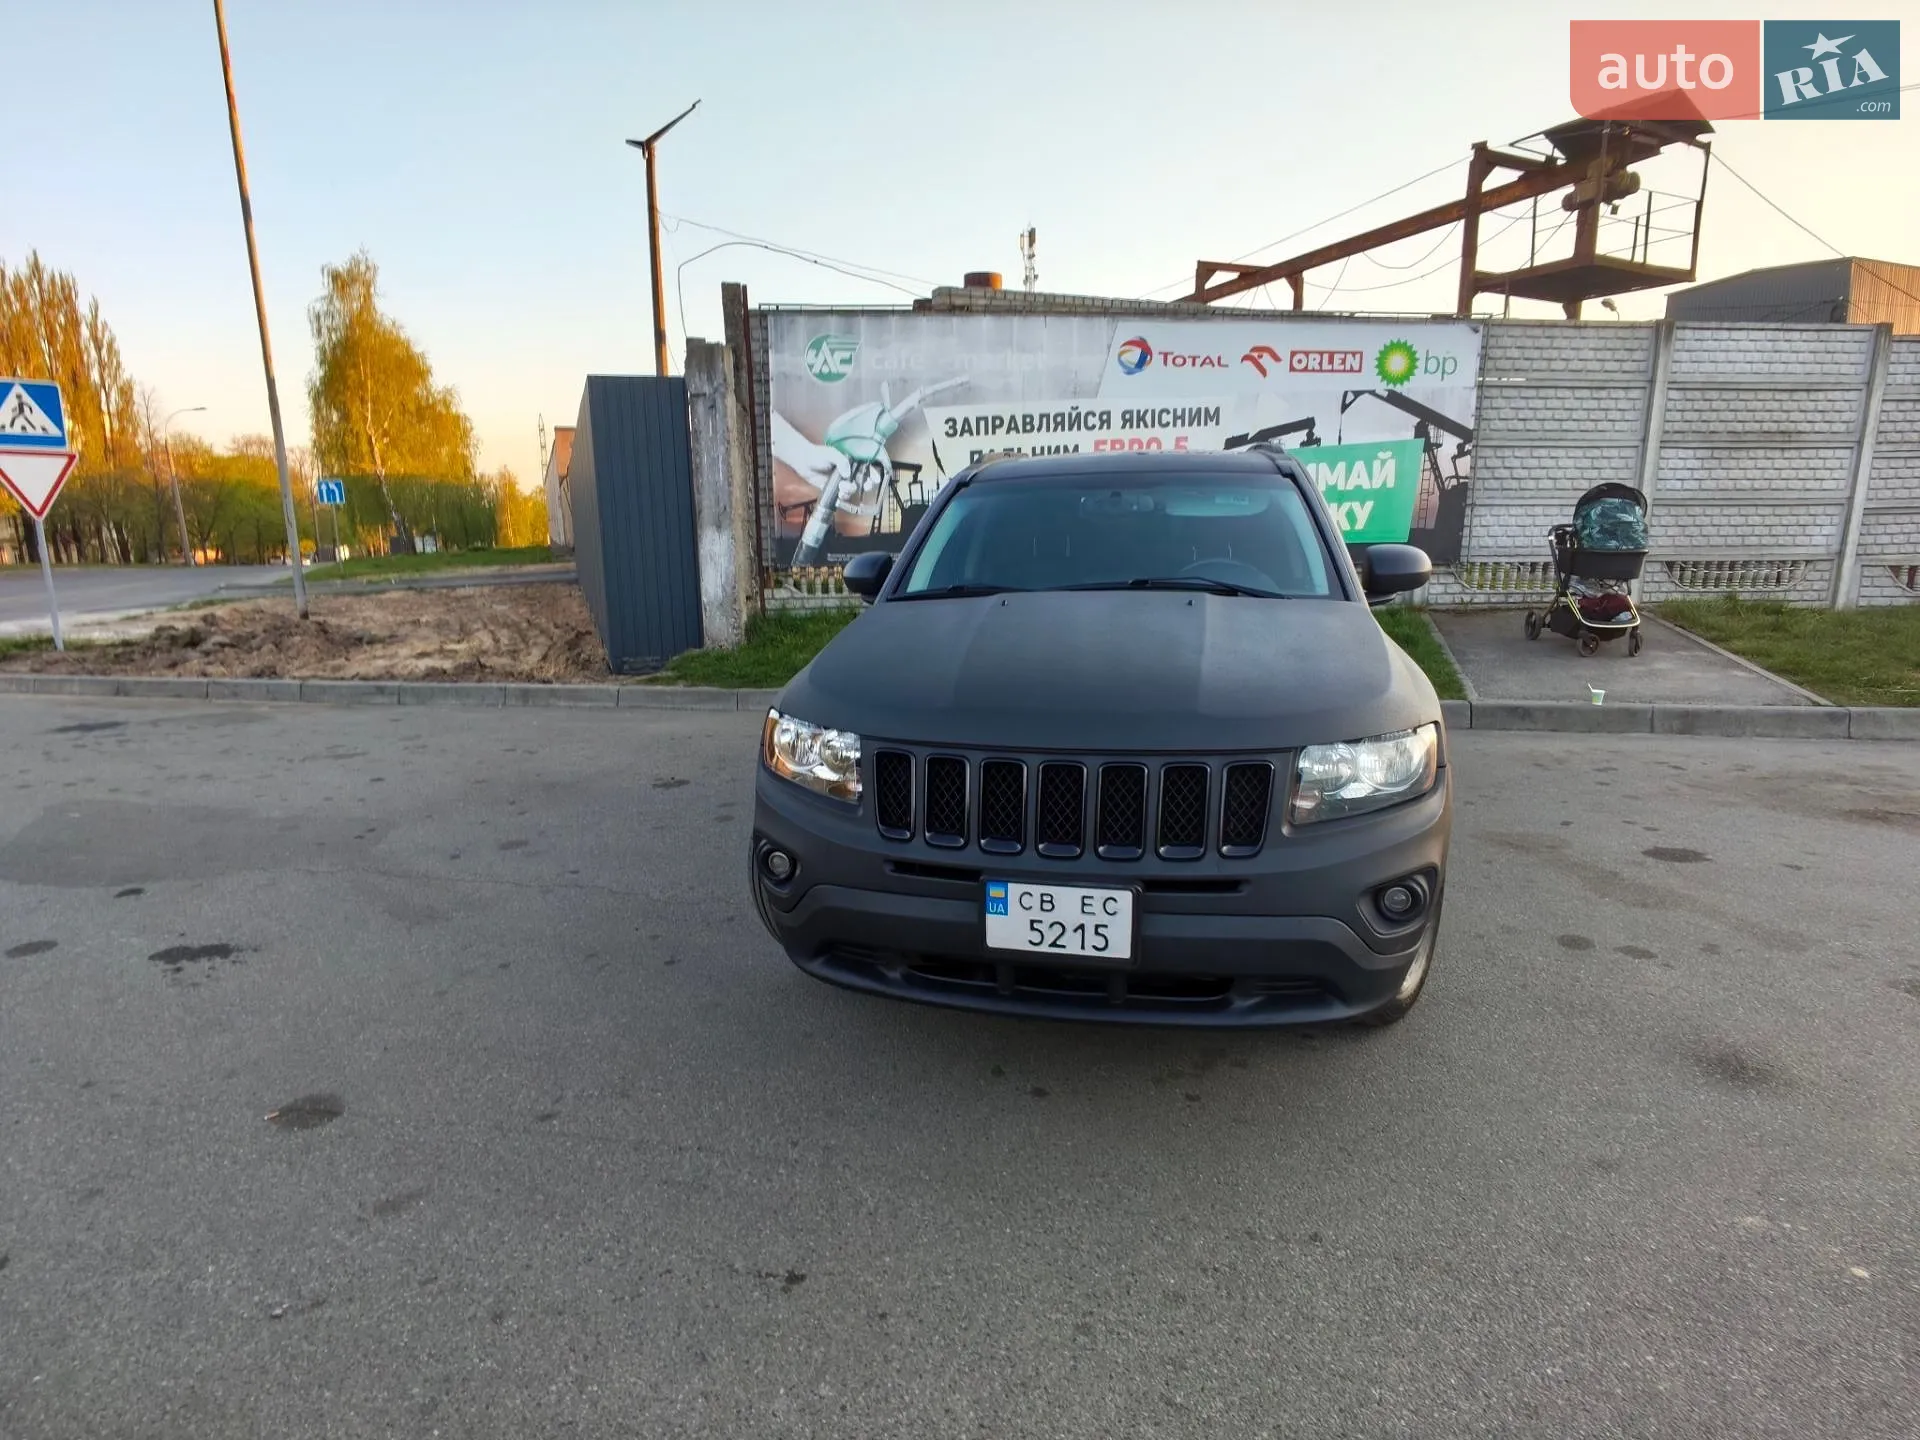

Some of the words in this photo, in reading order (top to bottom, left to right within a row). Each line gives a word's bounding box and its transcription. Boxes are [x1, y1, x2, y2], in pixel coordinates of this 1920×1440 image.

[1291, 352, 1362, 371] ORLEN
[1423, 349, 1458, 381] bp
[944, 406, 1112, 438] ЗАПРАВЛЯЙСЯ
[1120, 406, 1221, 430] ЯКІСНИМ
[988, 902, 1005, 914] UA
[1019, 891, 1056, 913] CB
[1081, 895, 1119, 917] EC
[1028, 918, 1109, 952] 5215
